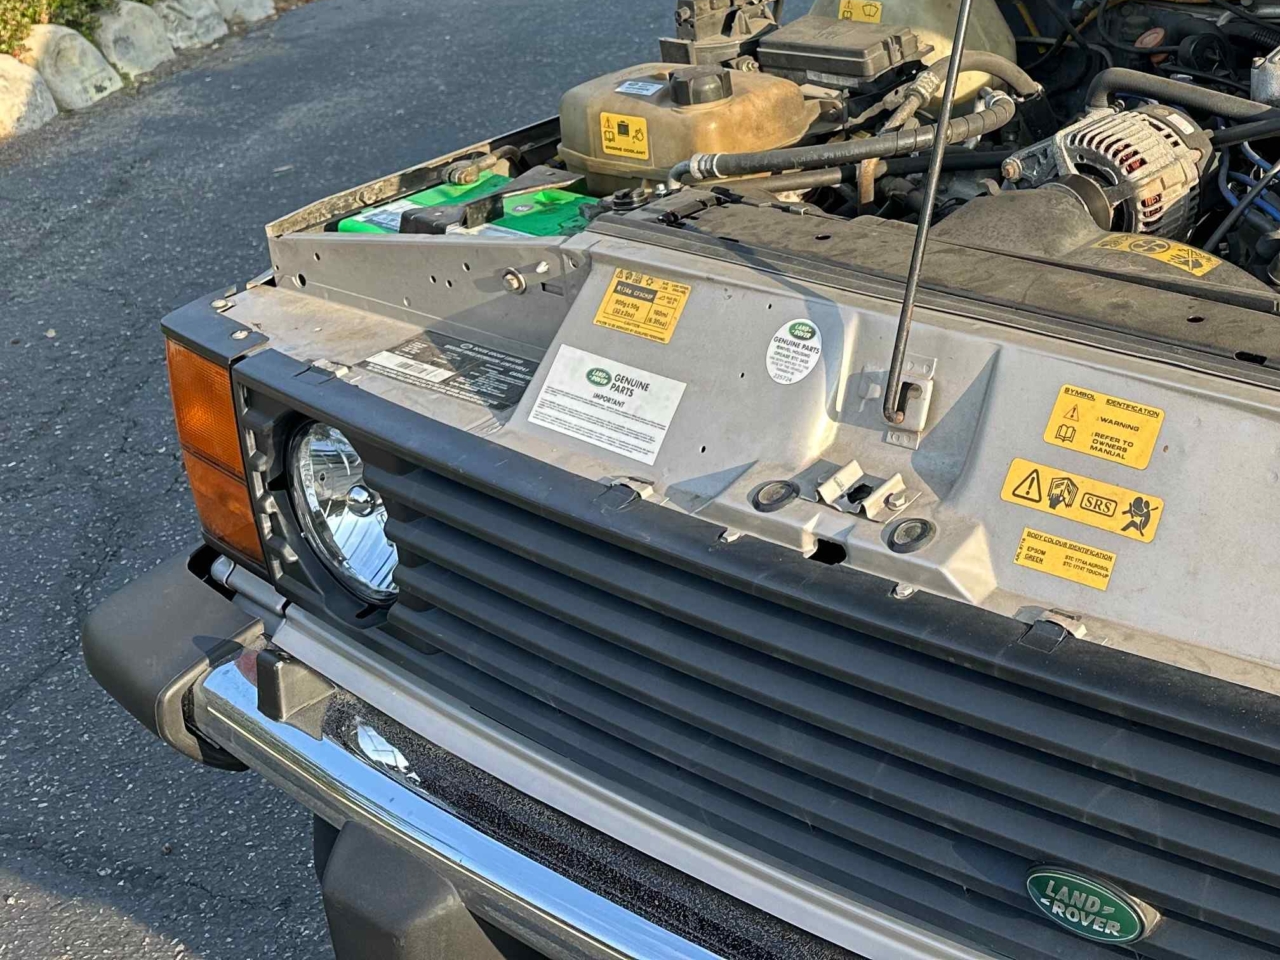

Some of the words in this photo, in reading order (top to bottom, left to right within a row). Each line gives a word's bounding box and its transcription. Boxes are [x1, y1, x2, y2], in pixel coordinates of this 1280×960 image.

[793, 330, 811, 339] ROVER
[794, 323, 809, 331] LAND
[773, 335, 801, 349] GENUINE
[801, 344, 820, 354] PARTS
[590, 375, 608, 385] ROVER
[591, 369, 606, 378] LAND
[610, 382, 634, 397] PARTS
[614, 373, 650, 392] GENUINE
[592, 392, 625, 408] IMPORTANT
[1064, 387, 1095, 401] SYMBOL
[1105, 398, 1160, 418] IDENTIFICATION
[1092, 438, 1128, 453] OWNERS
[1122, 439, 1134, 448] TO
[1089, 445, 1126, 460] MANUAL
[1084, 496, 1112, 514] SRS
[1026, 530, 1043, 540] BODY
[1043, 536, 1068, 548] COLOUR
[1068, 543, 1113, 562] IDENTIFICATION
[1026, 546, 1046, 556] EPSOM
[1023, 553, 1044, 564] GREEN
[1045, 879, 1101, 914] LAND
[1051, 901, 1121, 937] ROVER
